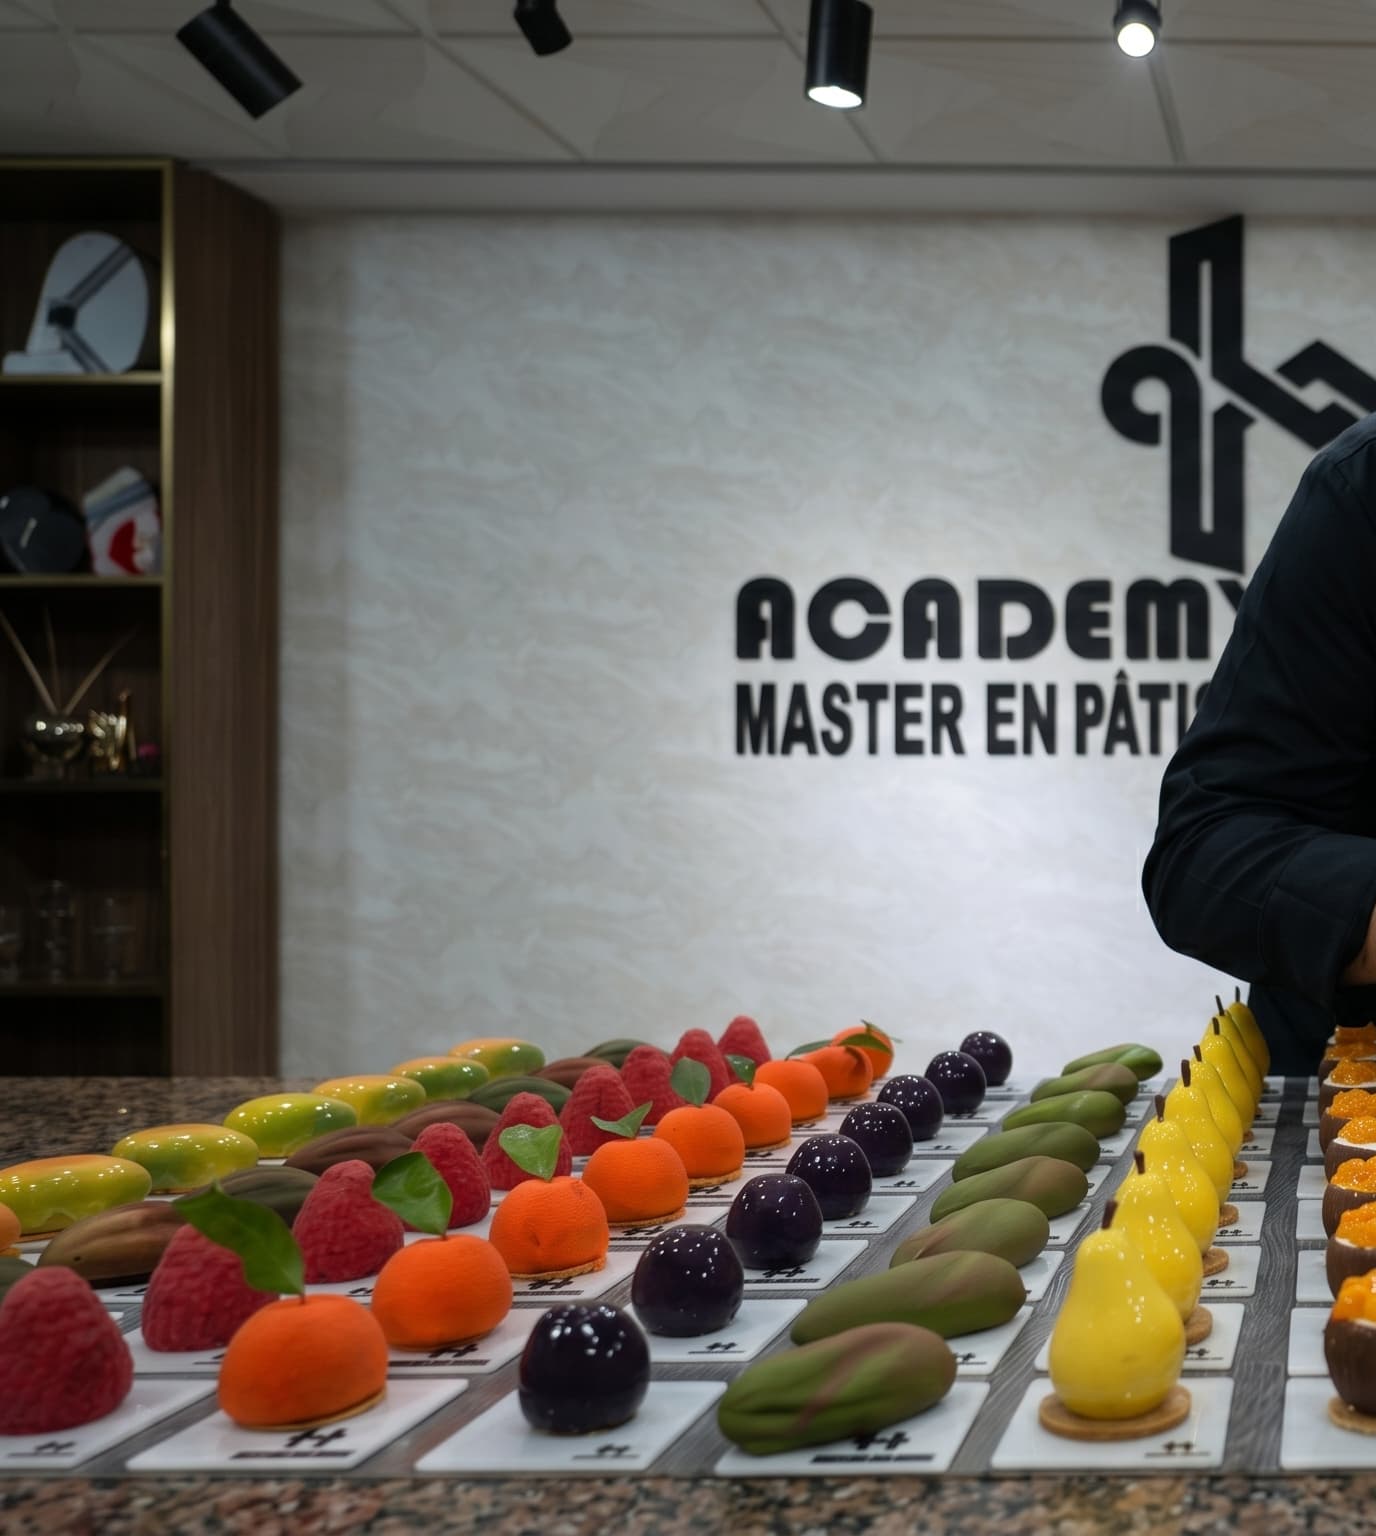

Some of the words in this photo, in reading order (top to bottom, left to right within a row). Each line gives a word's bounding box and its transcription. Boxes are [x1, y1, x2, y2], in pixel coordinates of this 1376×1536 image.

[735, 682, 966, 757] MASTER
[986, 682, 1057, 757] EN
[1074, 669, 1212, 757] PÂTI
